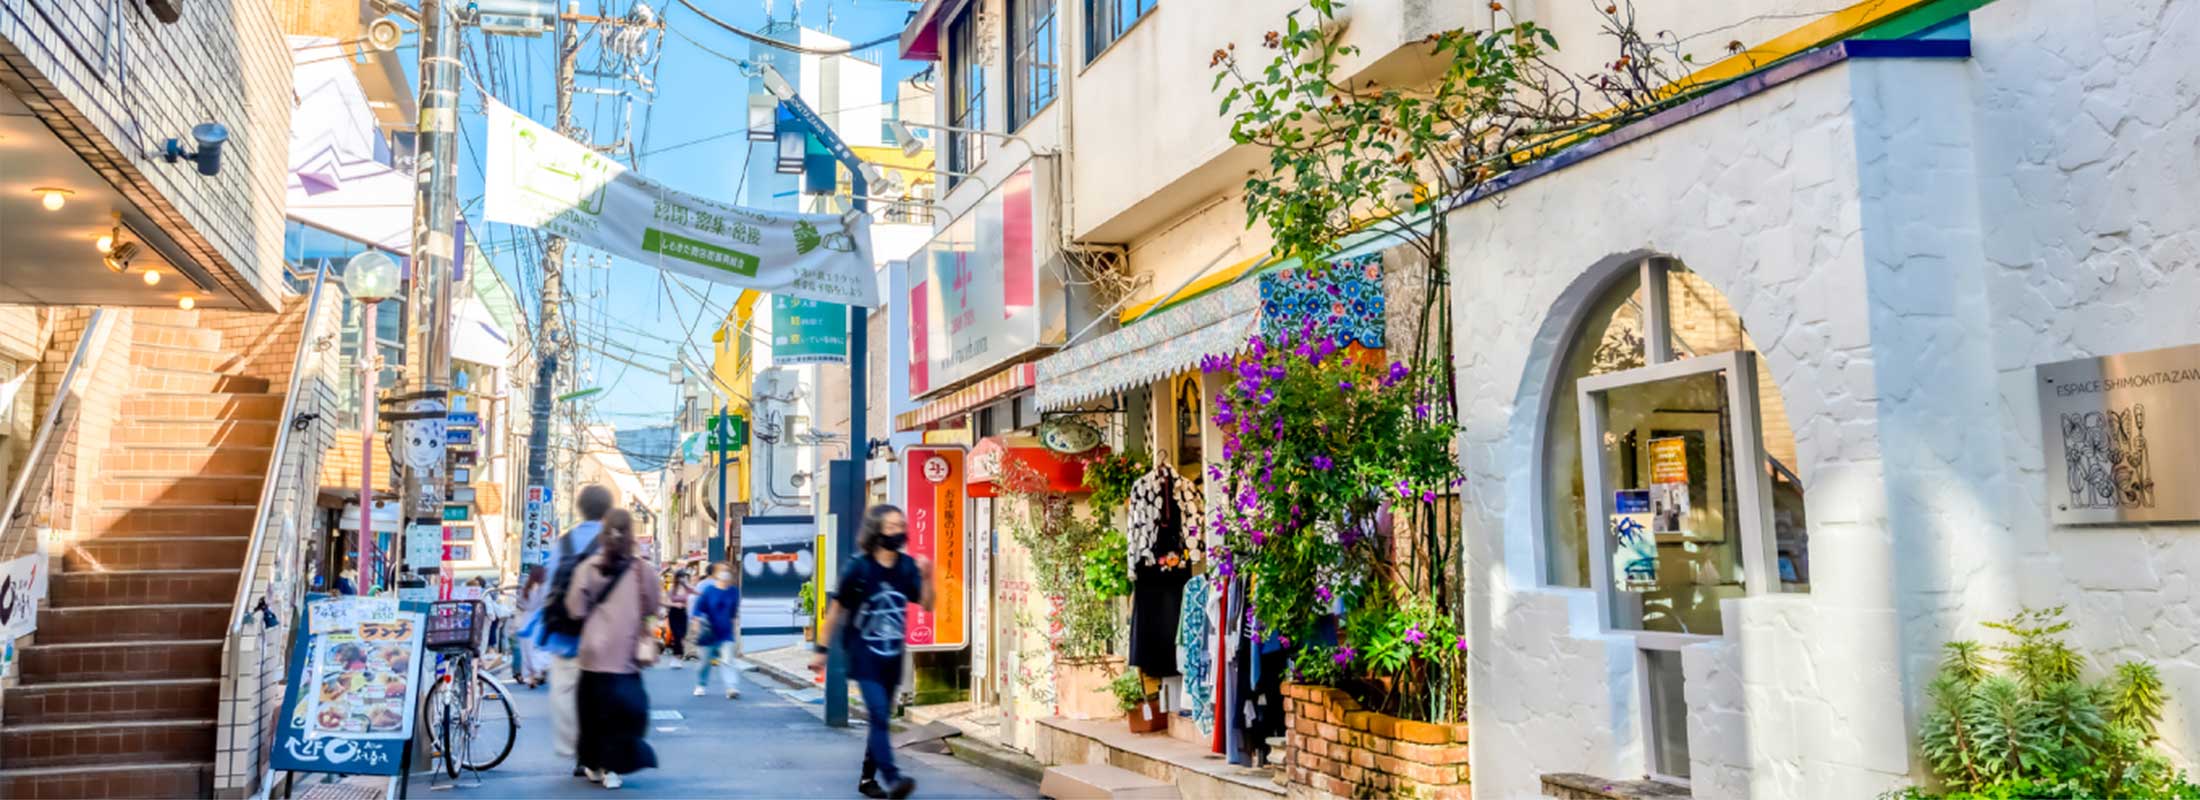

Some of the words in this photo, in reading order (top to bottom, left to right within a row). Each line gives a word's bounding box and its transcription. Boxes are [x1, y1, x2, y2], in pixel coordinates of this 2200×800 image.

[2056, 380, 2101, 398] ESPACE
[944, 489, 955, 579] お洋服のリフォーム
[363, 620, 412, 639] ランチ
